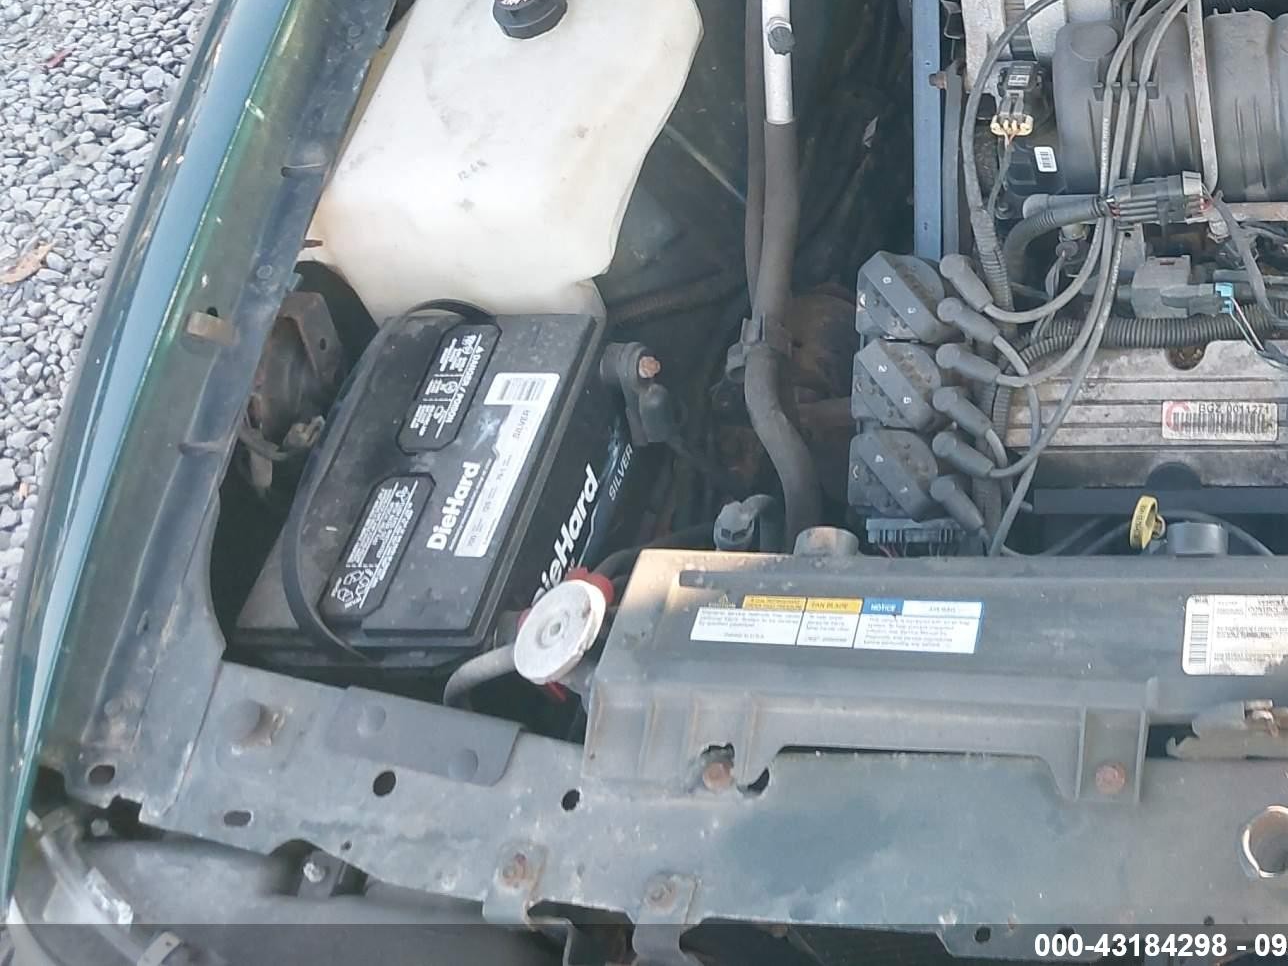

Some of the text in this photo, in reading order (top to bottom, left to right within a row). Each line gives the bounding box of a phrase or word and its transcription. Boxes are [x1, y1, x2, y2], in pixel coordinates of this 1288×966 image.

[878, 364, 888, 373] 2
[608, 443, 633, 501] SILVER
[426, 461, 481, 550] DieHard
